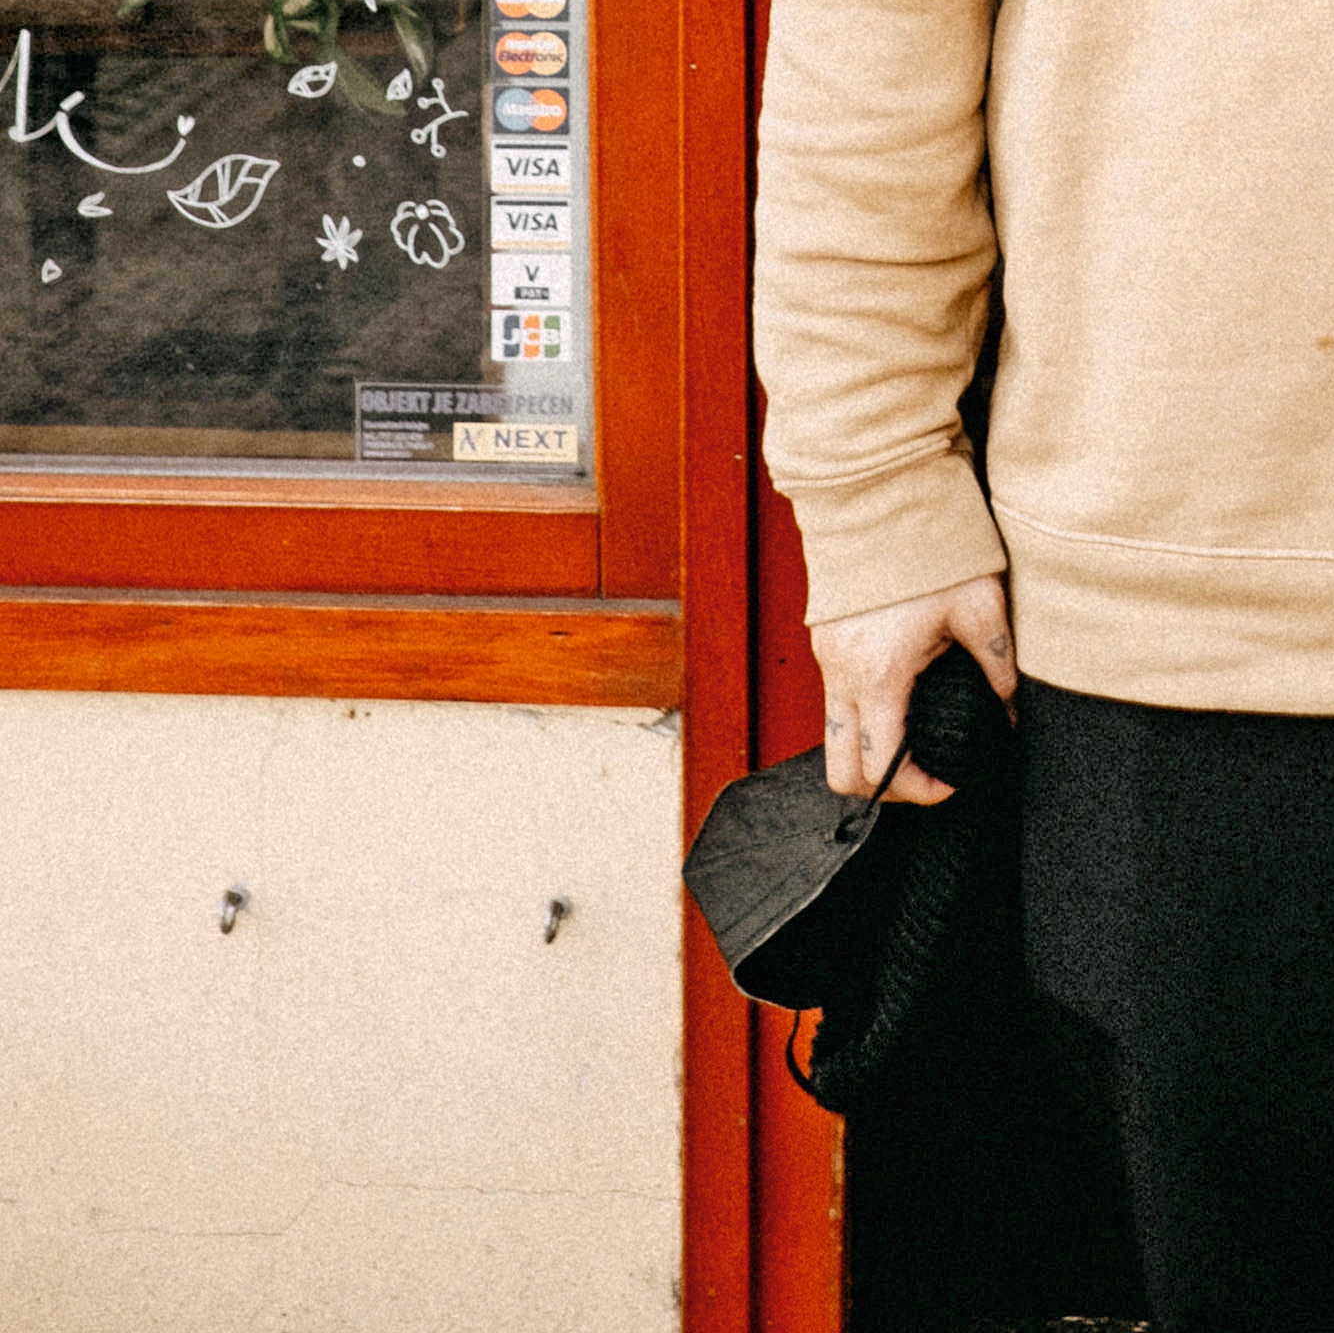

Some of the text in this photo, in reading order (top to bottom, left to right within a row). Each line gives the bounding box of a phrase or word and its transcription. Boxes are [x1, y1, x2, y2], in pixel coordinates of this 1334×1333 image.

[505, 156, 561, 177] VISA
[505, 212, 559, 231] VISA
[362, 390, 432, 414] OBJEKT
[432, 391, 453, 414] JE
[494, 429, 568, 450] NEXT
